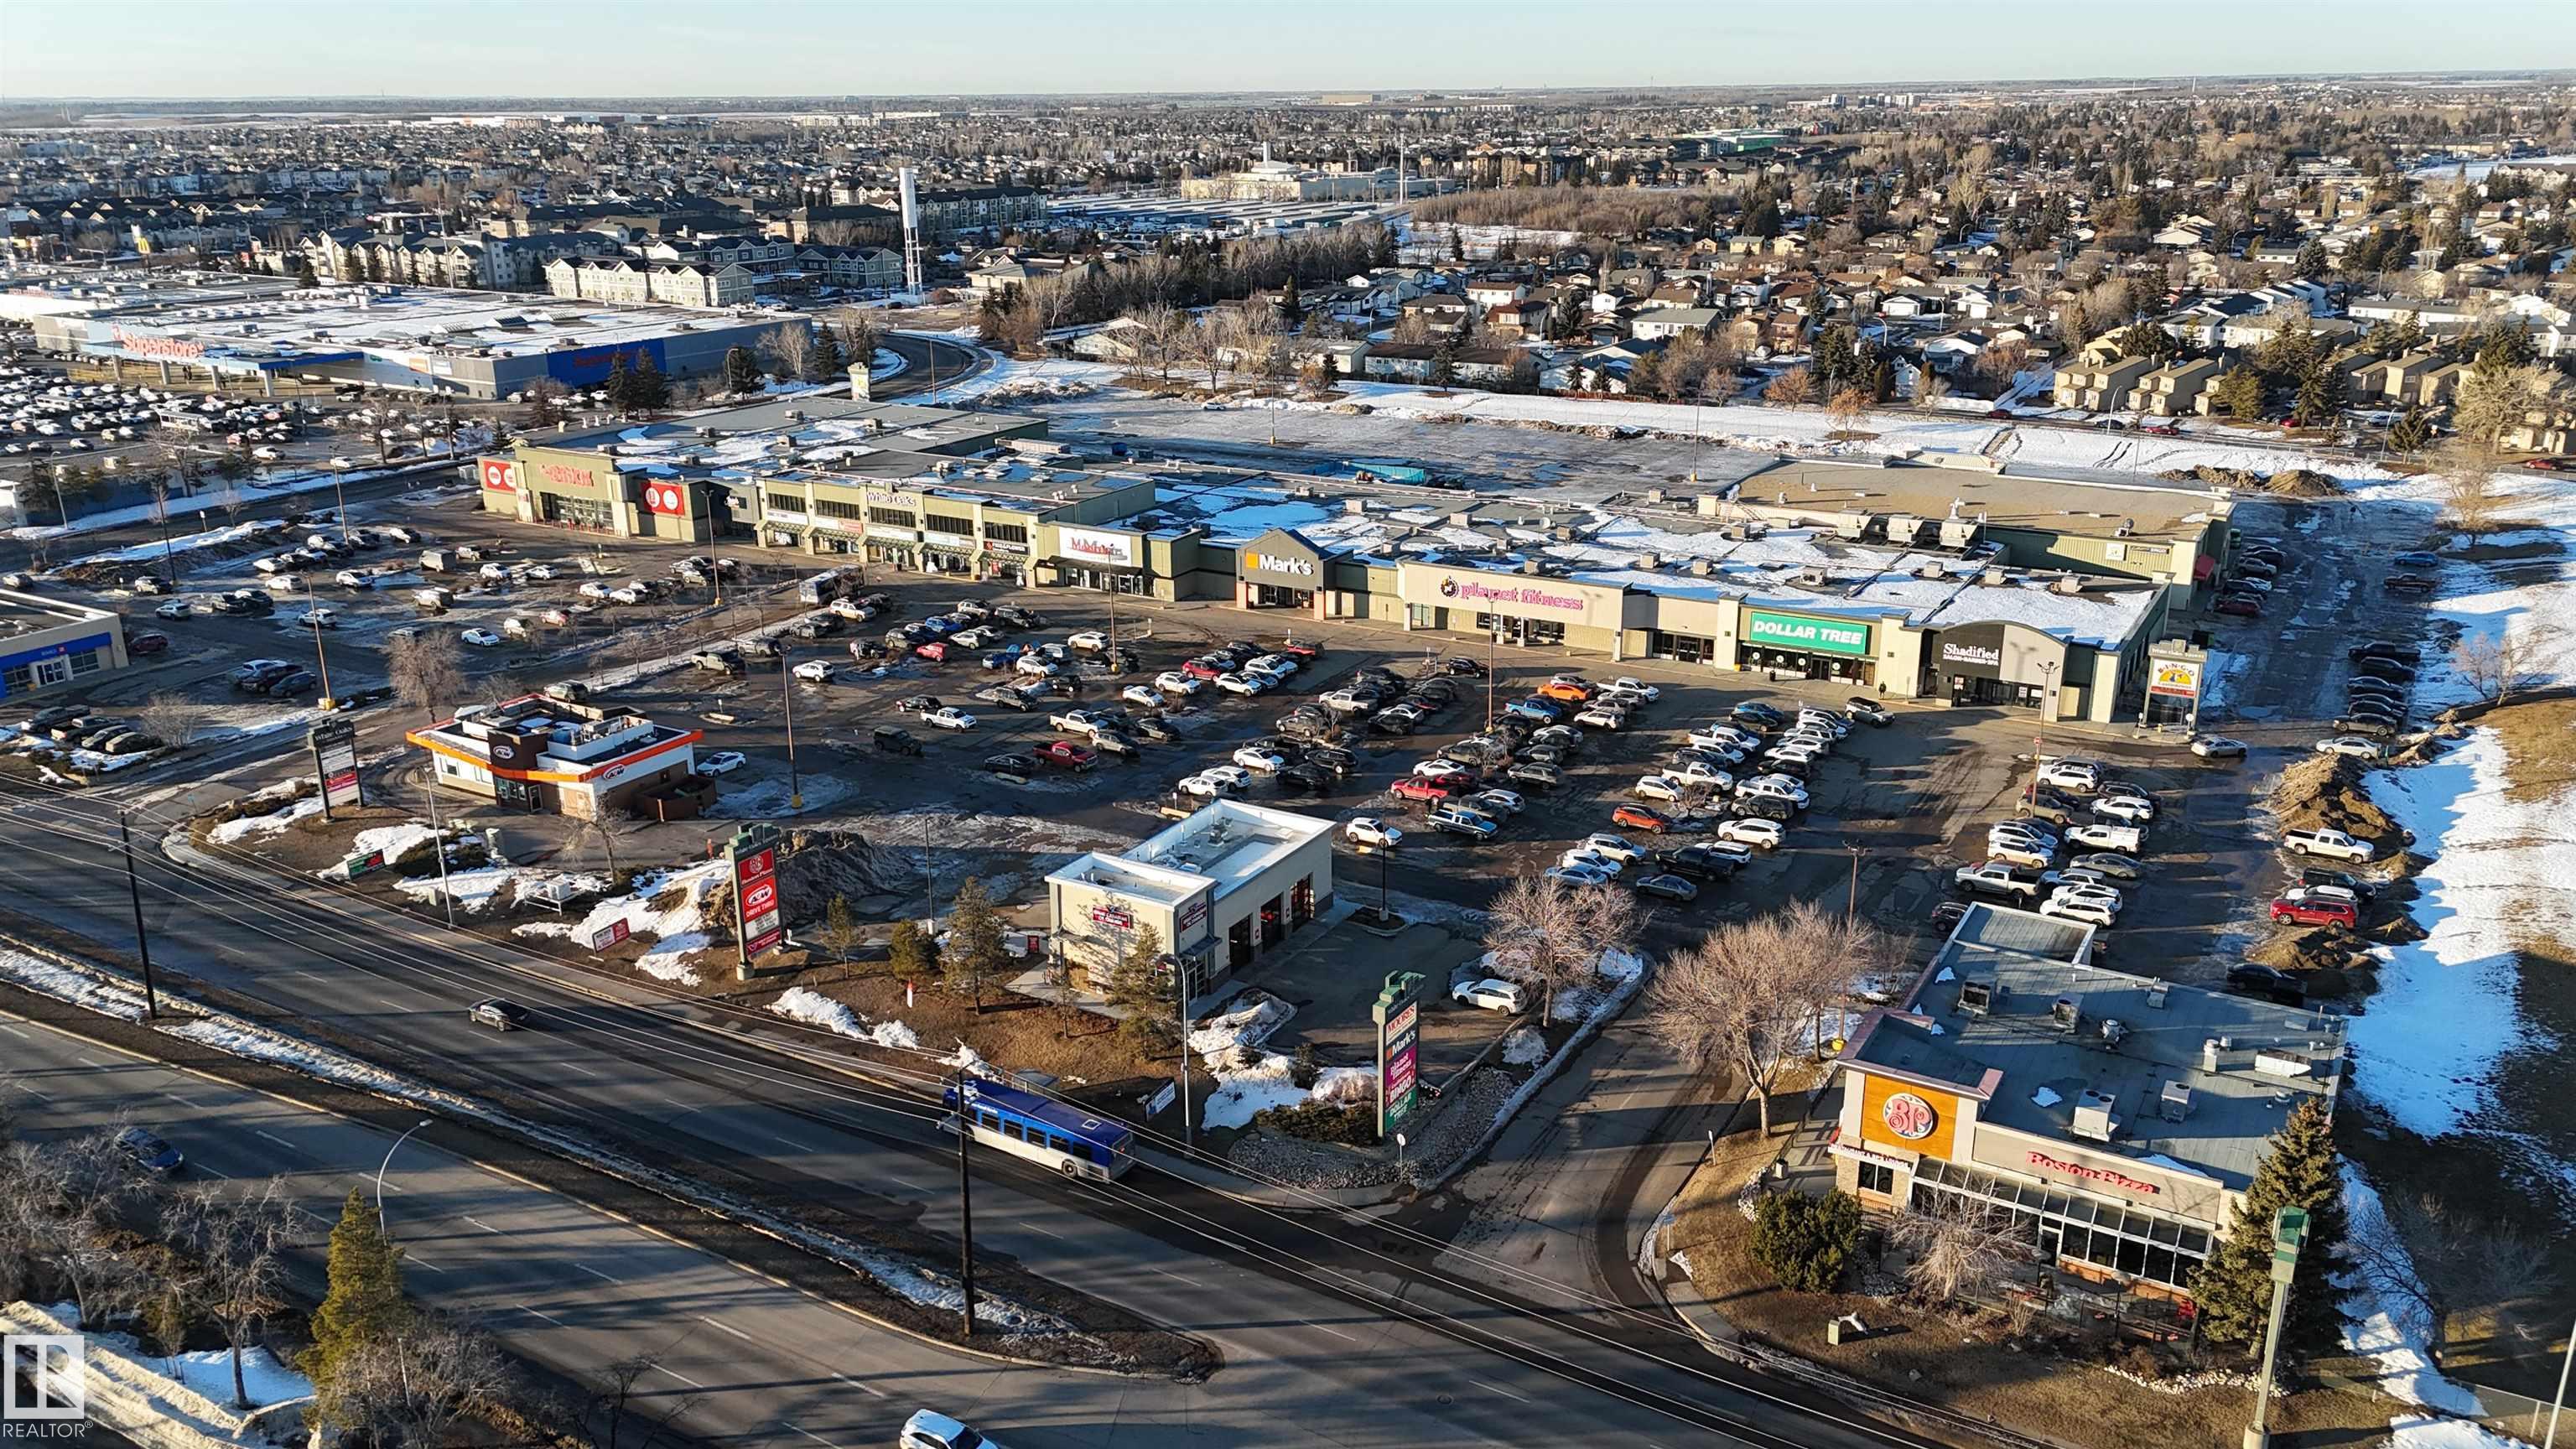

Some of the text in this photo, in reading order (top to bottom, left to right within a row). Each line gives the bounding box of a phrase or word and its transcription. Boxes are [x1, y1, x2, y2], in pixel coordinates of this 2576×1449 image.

[1259, 553, 1313, 576] Mark's
[1461, 582, 1519, 602] planet
[1520, 589, 1583, 610] fitness
[1753, 621, 1863, 644] DOLLAR TREE
[1943, 643, 1999, 659] Shadified
[745, 906, 762, 917] DRIVE
[1387, 1005, 1415, 1034] MOORES
[1392, 1030, 1416, 1055] Mark's
[1389, 1092, 1412, 1117] DOLLAR
[2026, 1151, 2156, 1195] Boston Pizza
